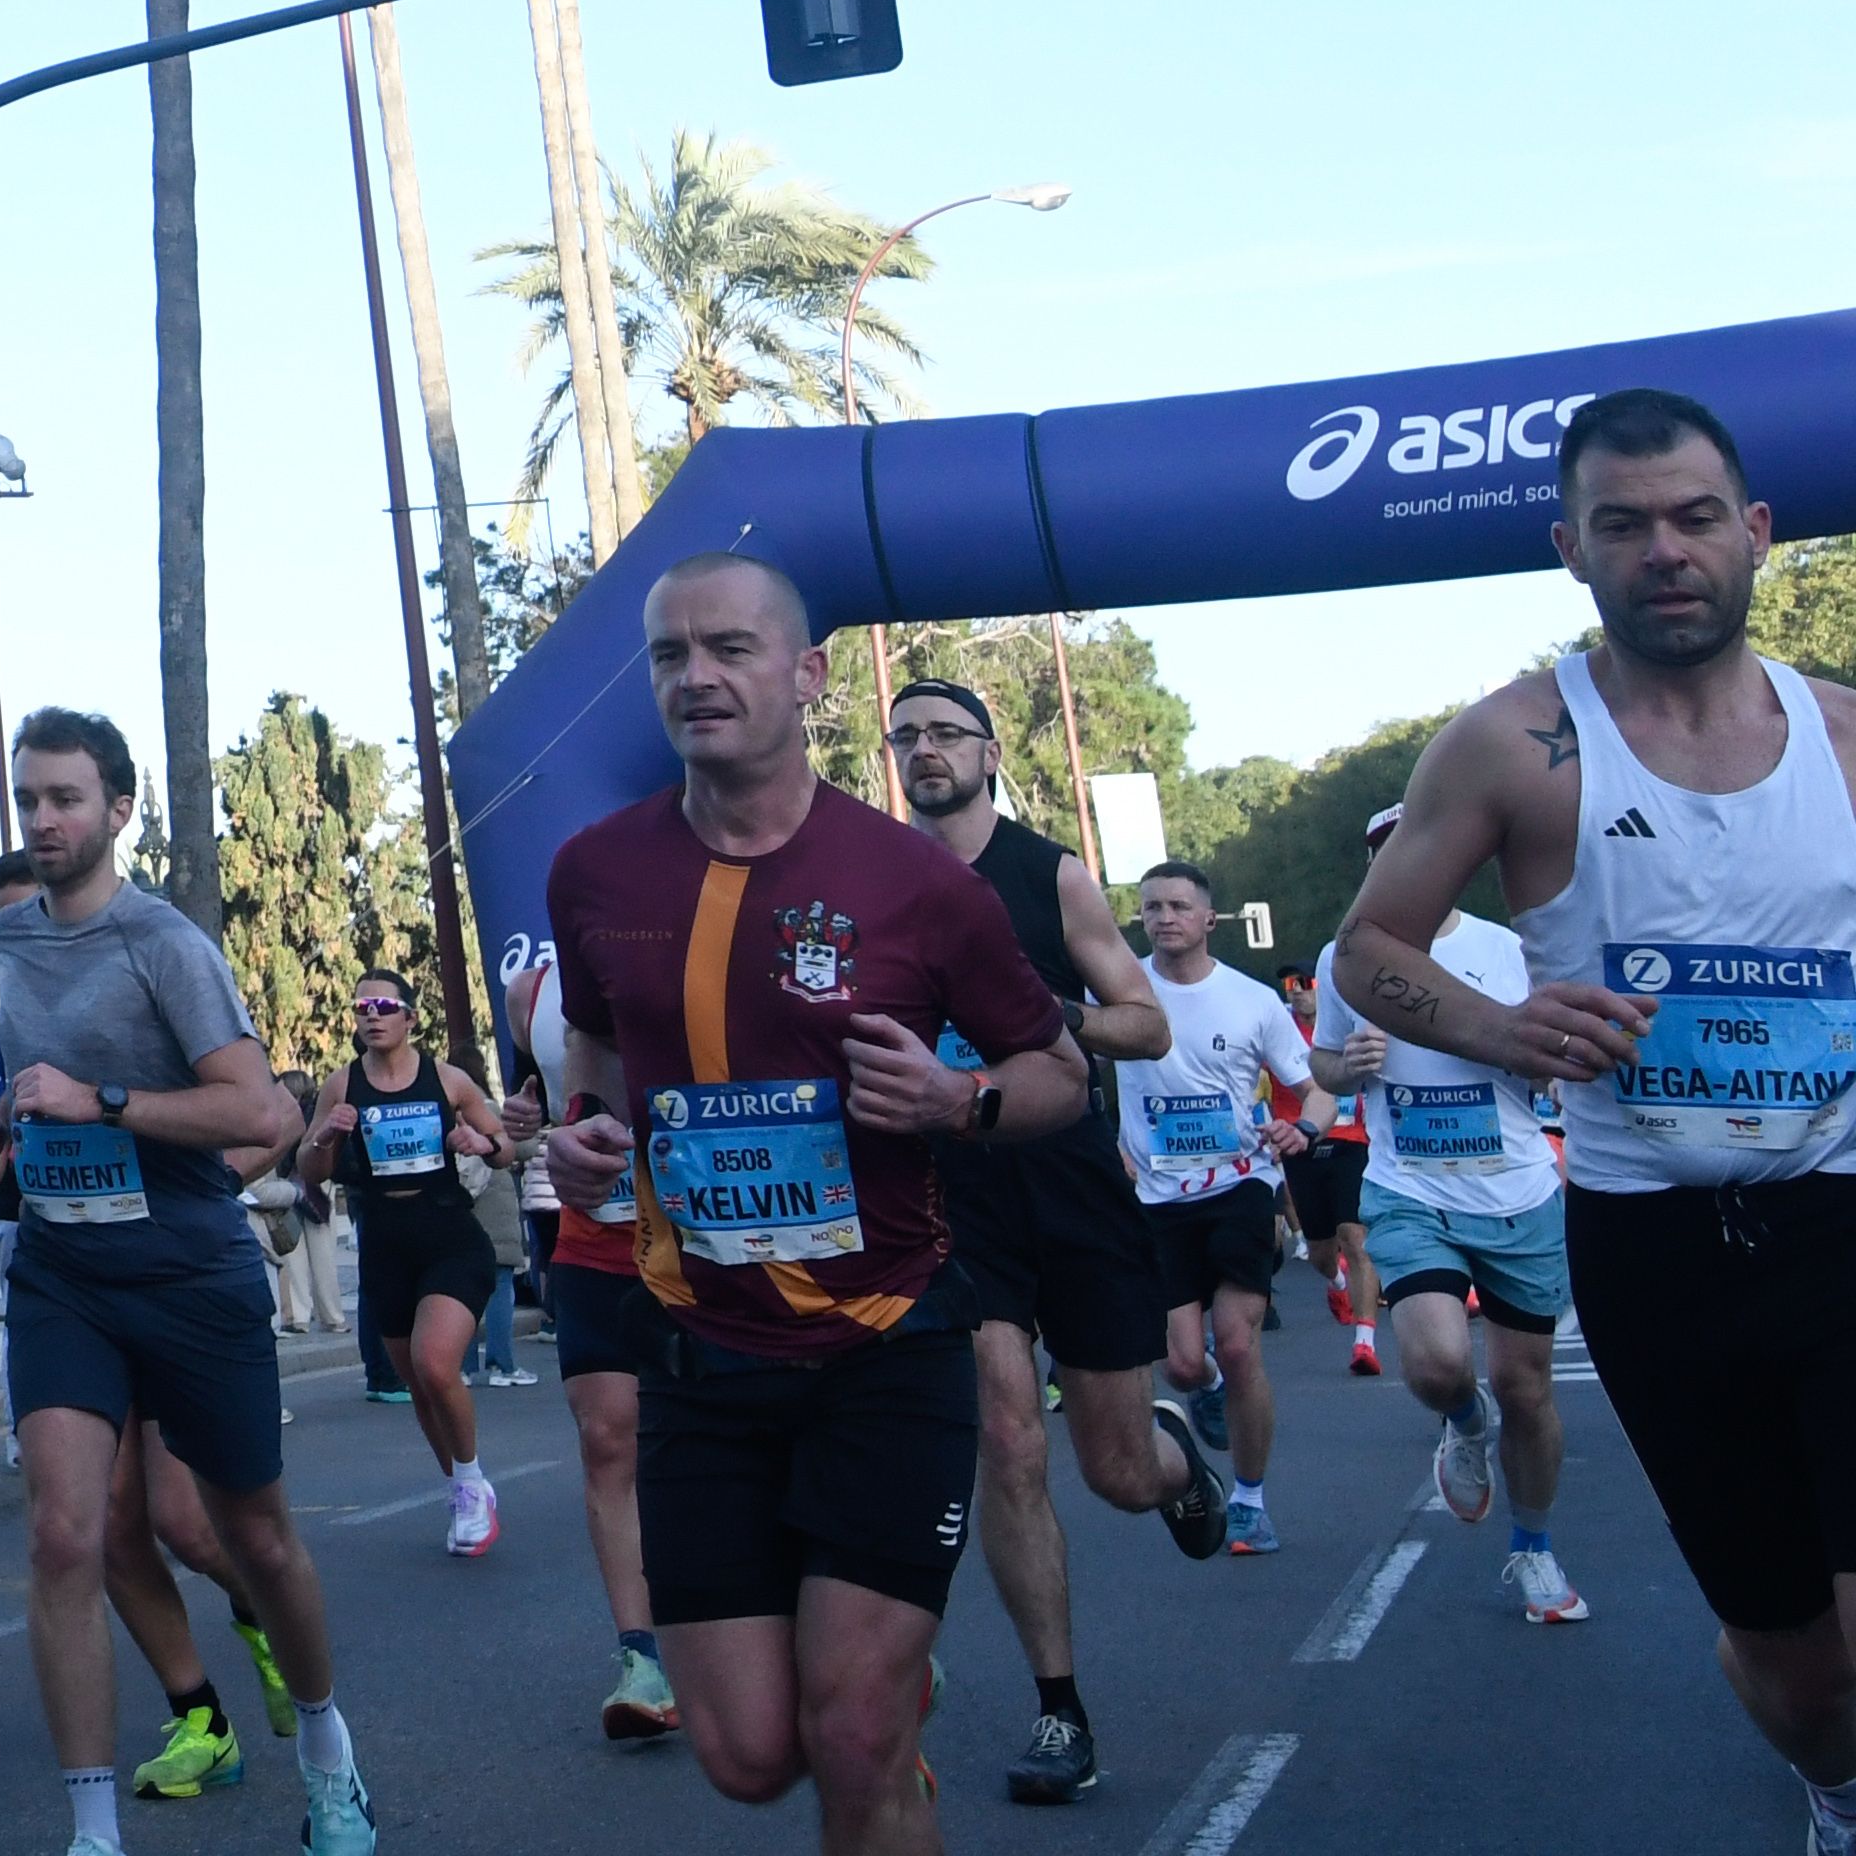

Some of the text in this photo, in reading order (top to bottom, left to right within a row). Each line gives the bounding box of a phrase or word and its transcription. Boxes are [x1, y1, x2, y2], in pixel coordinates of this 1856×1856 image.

[1384, 491, 1453, 519] sound
[1458, 484, 1518, 511] mind,
[1689, 958, 1825, 988] ZURICH
[1371, 966, 1440, 1025] VEGA
[1696, 1018, 1771, 1046] 7965
[699, 1091, 814, 1119] ZURICH
[1171, 1097, 1221, 1111] ZURICH
[1421, 1089, 1482, 1104] ZURICH
[385, 1105, 431, 1119] ZURICH
[1425, 1116, 1460, 1131] 7813
[45, 1139, 82, 1157] 6757
[386, 1140, 426, 1157] ESME
[1165, 1135, 1223, 1153] PAWEL
[1394, 1134, 1504, 1154] CONCANNON
[711, 1147, 773, 1173] 8508
[22, 1162, 129, 1191] CLEMENT
[687, 1180, 818, 1222] KELVIN
